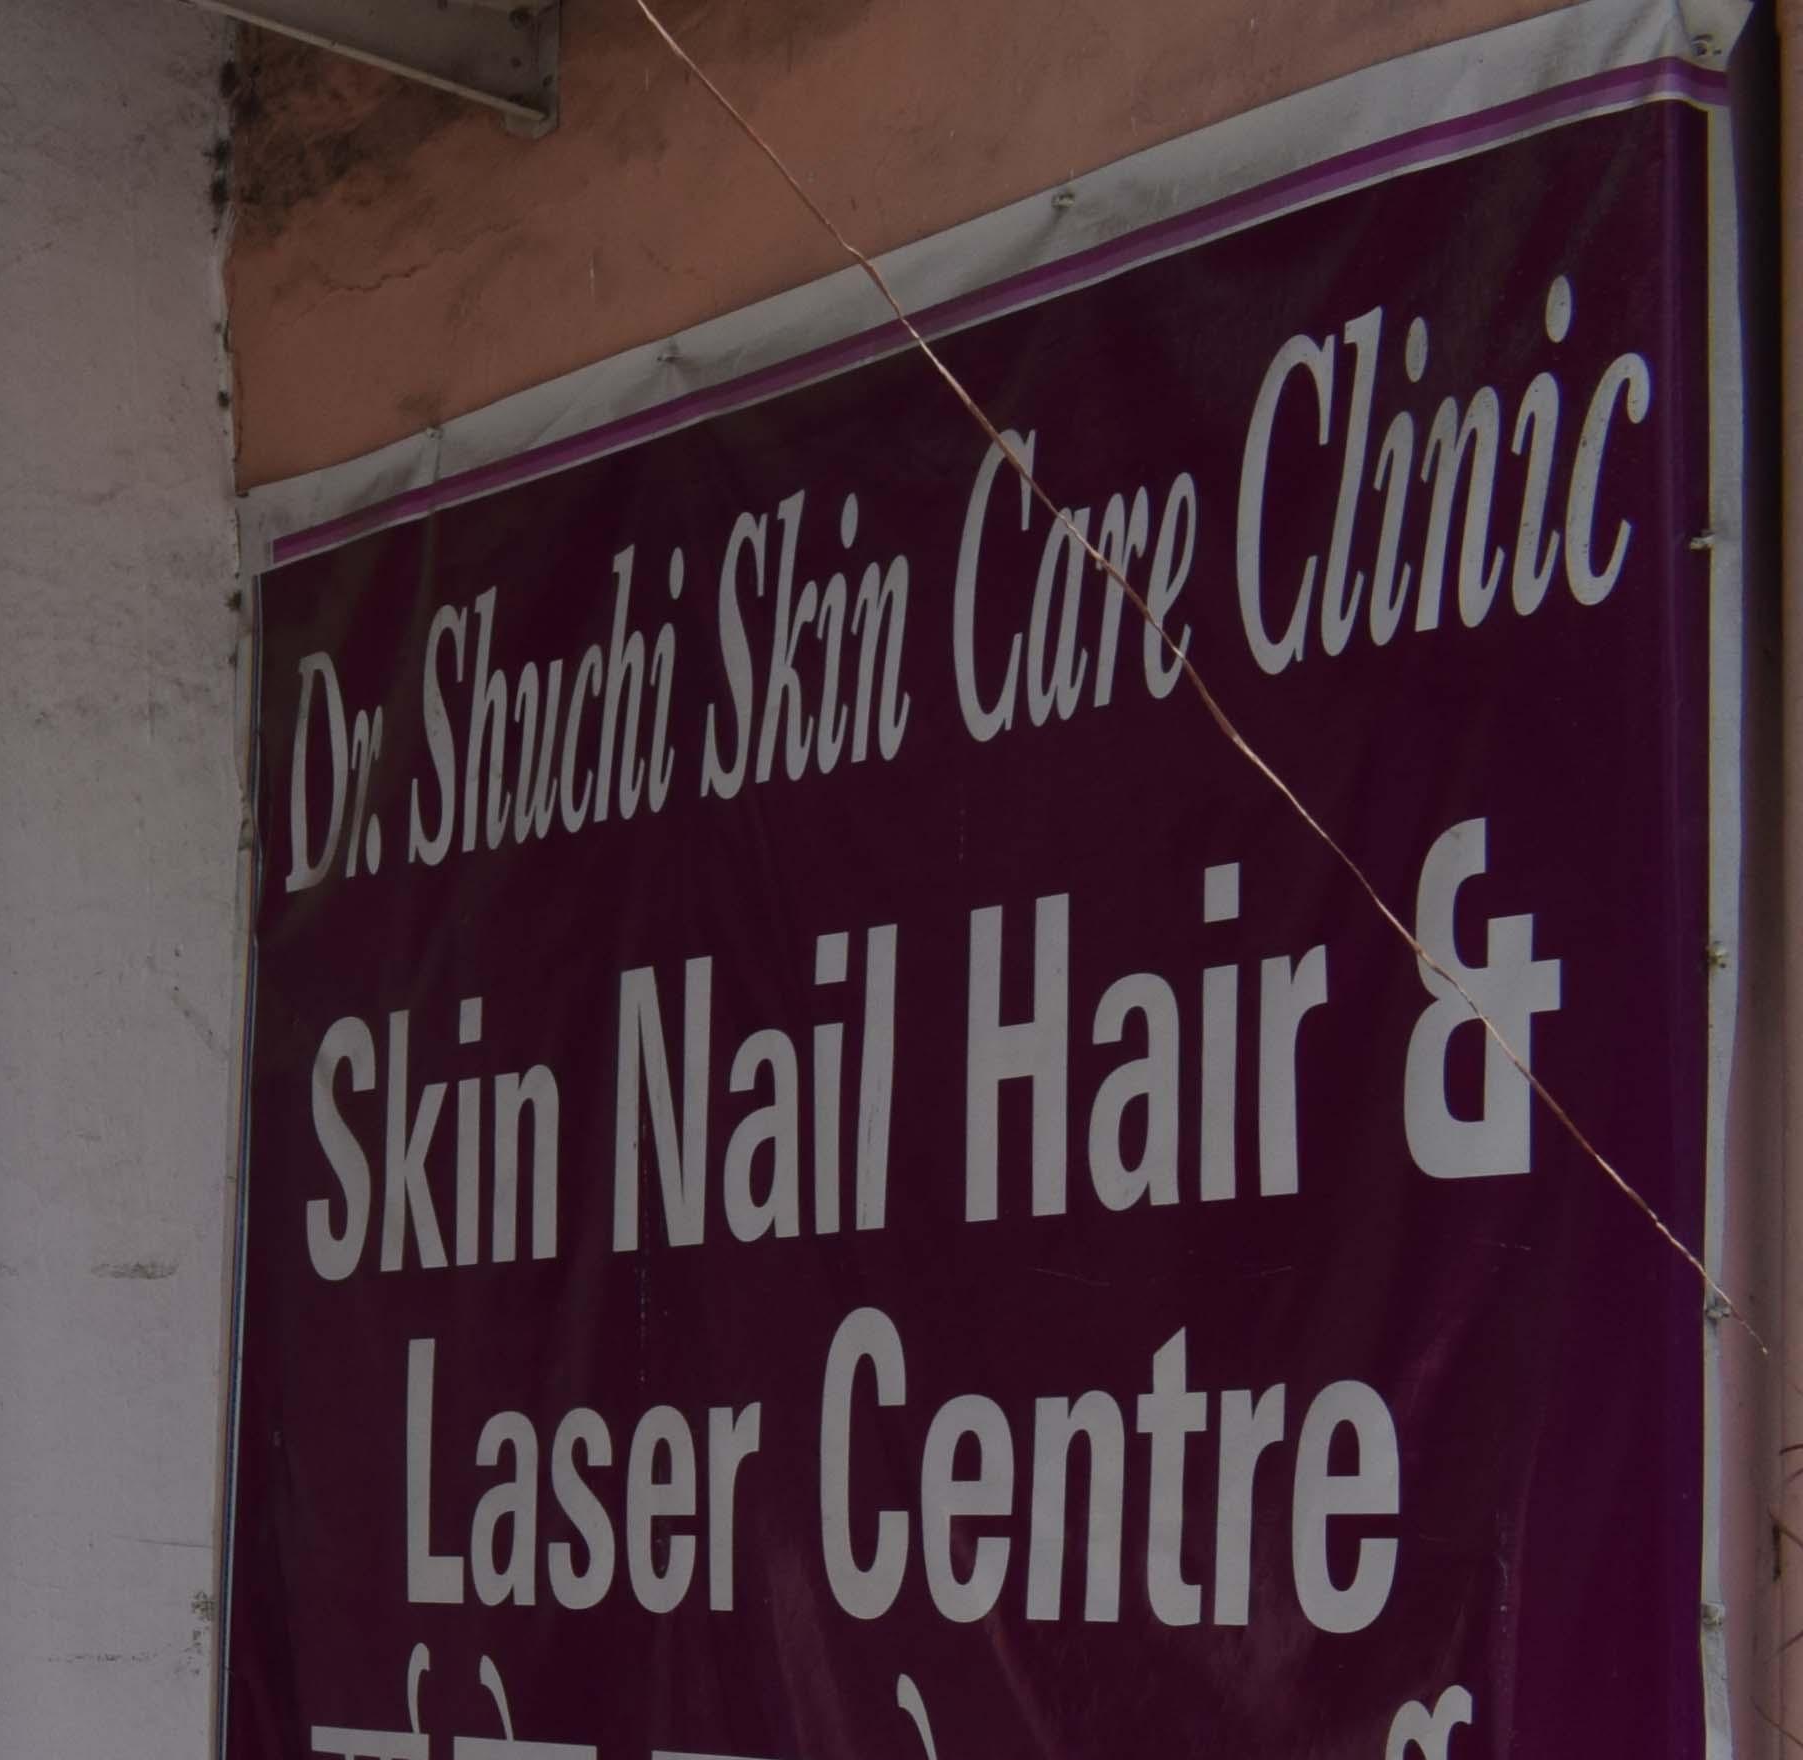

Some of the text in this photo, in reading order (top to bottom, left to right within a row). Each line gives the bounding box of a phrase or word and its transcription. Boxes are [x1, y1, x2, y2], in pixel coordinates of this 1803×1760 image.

[286, 276, 1650, 892] Dr. Shuchi Skin Care Clinic
[307, 817, 1562, 1280] Skin Nail Hair &
[407, 1307, 1399, 1633] Laser Centre
